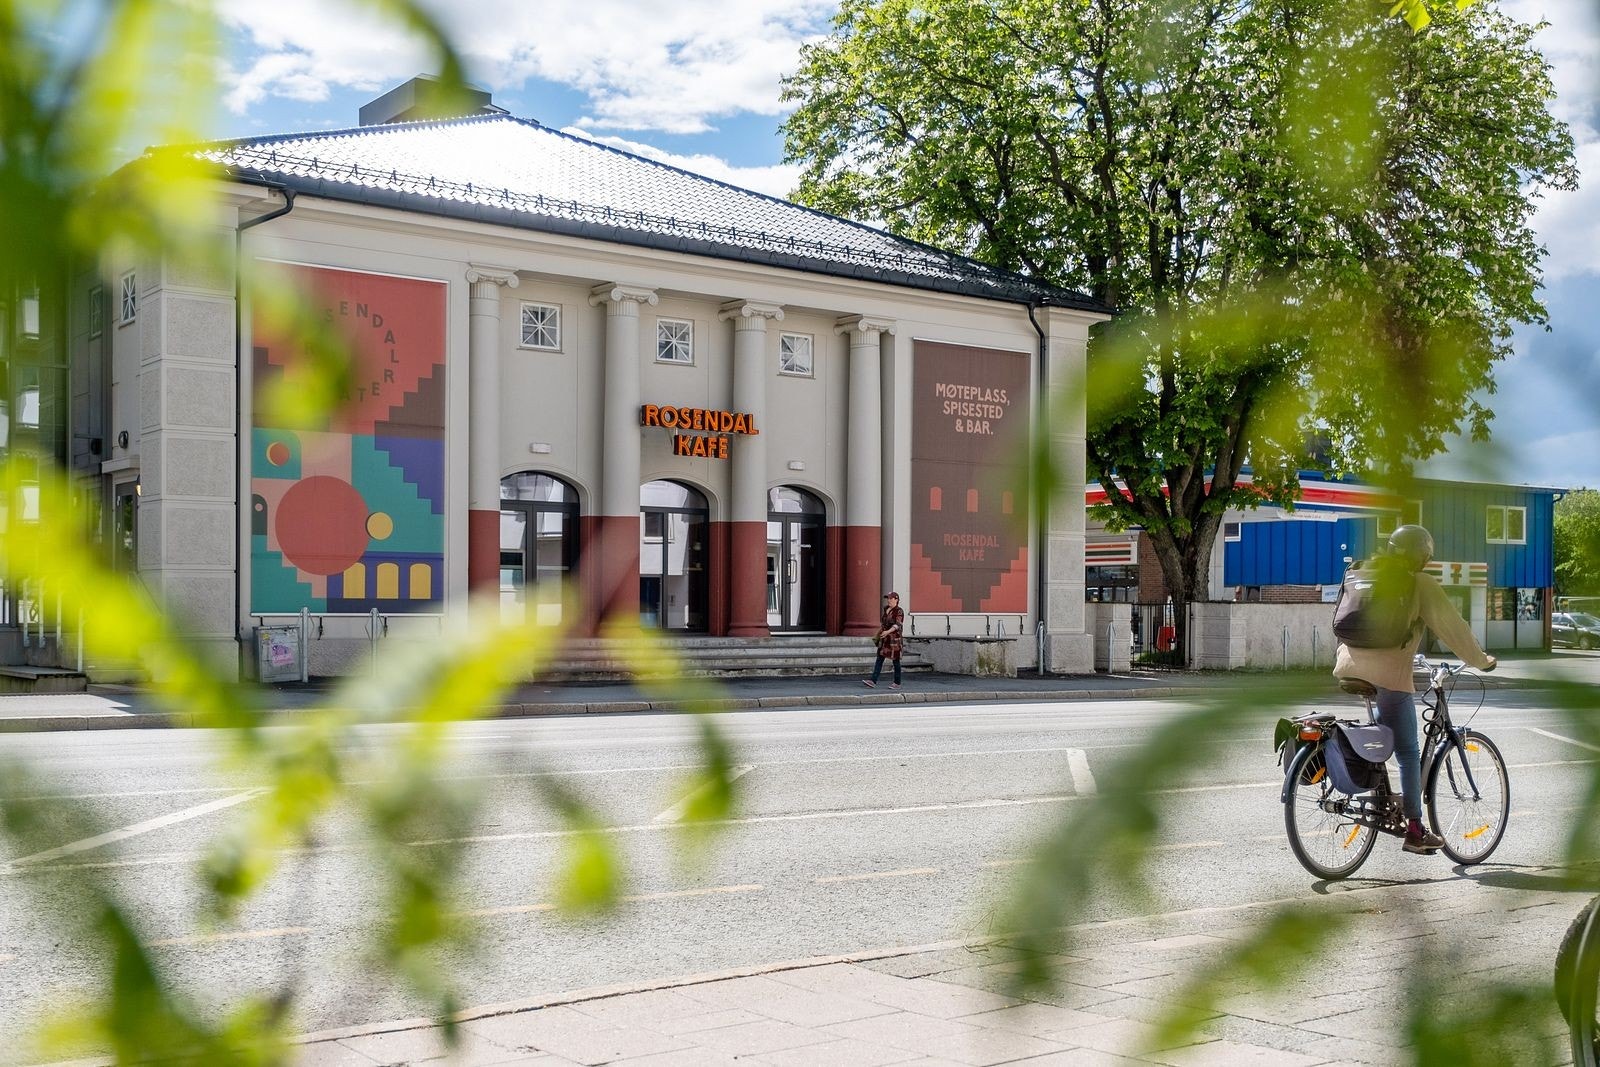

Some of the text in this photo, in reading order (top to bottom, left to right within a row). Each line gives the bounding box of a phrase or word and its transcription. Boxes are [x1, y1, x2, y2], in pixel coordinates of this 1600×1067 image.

[308, 301, 400, 364] SENDAL
[935, 382, 1010, 406] MØTEPLASS,
[641, 404, 760, 435] ROSENDAL
[942, 400, 1004, 419] SPISESTED
[955, 418, 994, 435] & BAR.
[943, 533, 1000, 548] ROSENDAL
